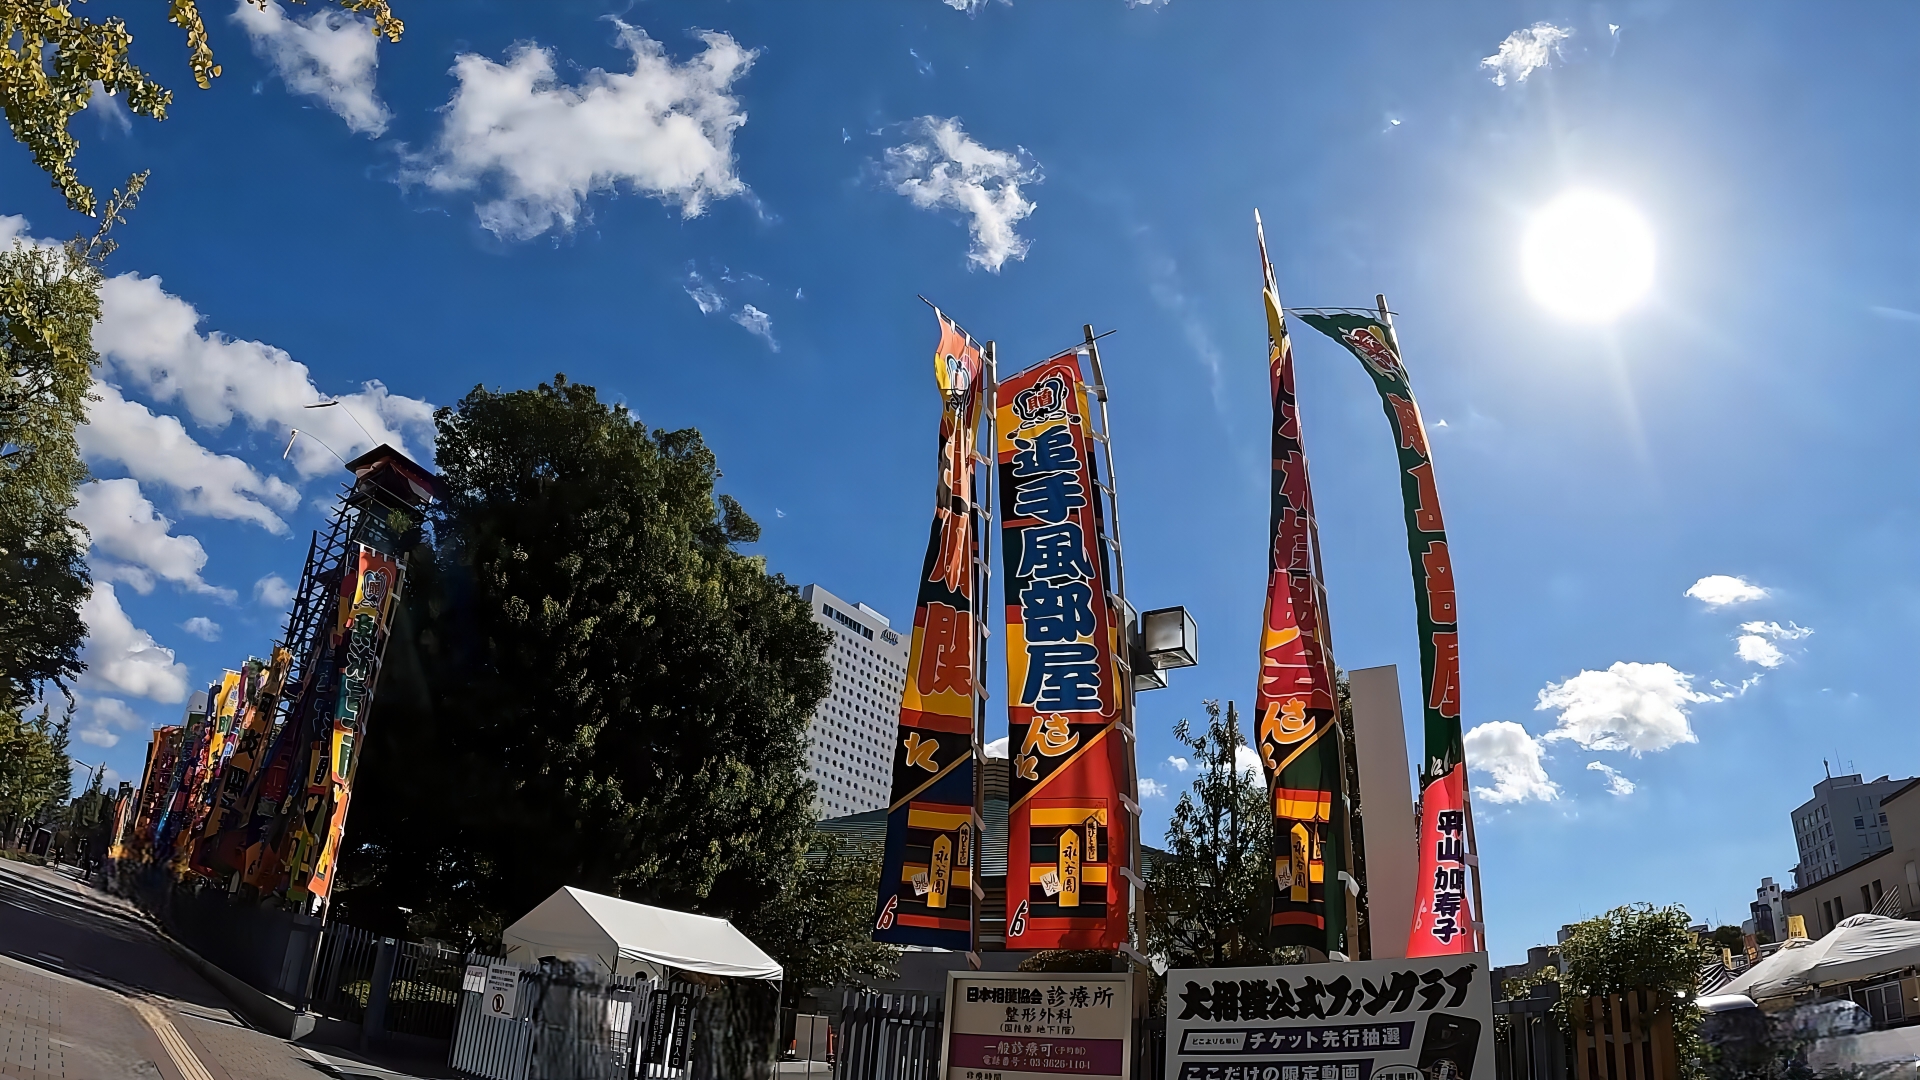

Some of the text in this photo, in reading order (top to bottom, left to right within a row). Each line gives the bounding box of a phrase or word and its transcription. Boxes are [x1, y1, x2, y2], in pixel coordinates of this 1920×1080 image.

[1011, 424, 1104, 714] 追手風部屋
[933, 844, 949, 896] 永谷園
[1061, 840, 1079, 894] 永谷園
[1431, 808, 1466, 945] 平山加寿子
[966, 985, 1114, 1009] 日本相撲協会 診療所
[1004, 1006, 1073, 1025] 整形外科
[1177, 963, 1478, 1022] 大相撲公式ファンクラブ
[1249, 1026, 1401, 1049] チケット先行抽選
